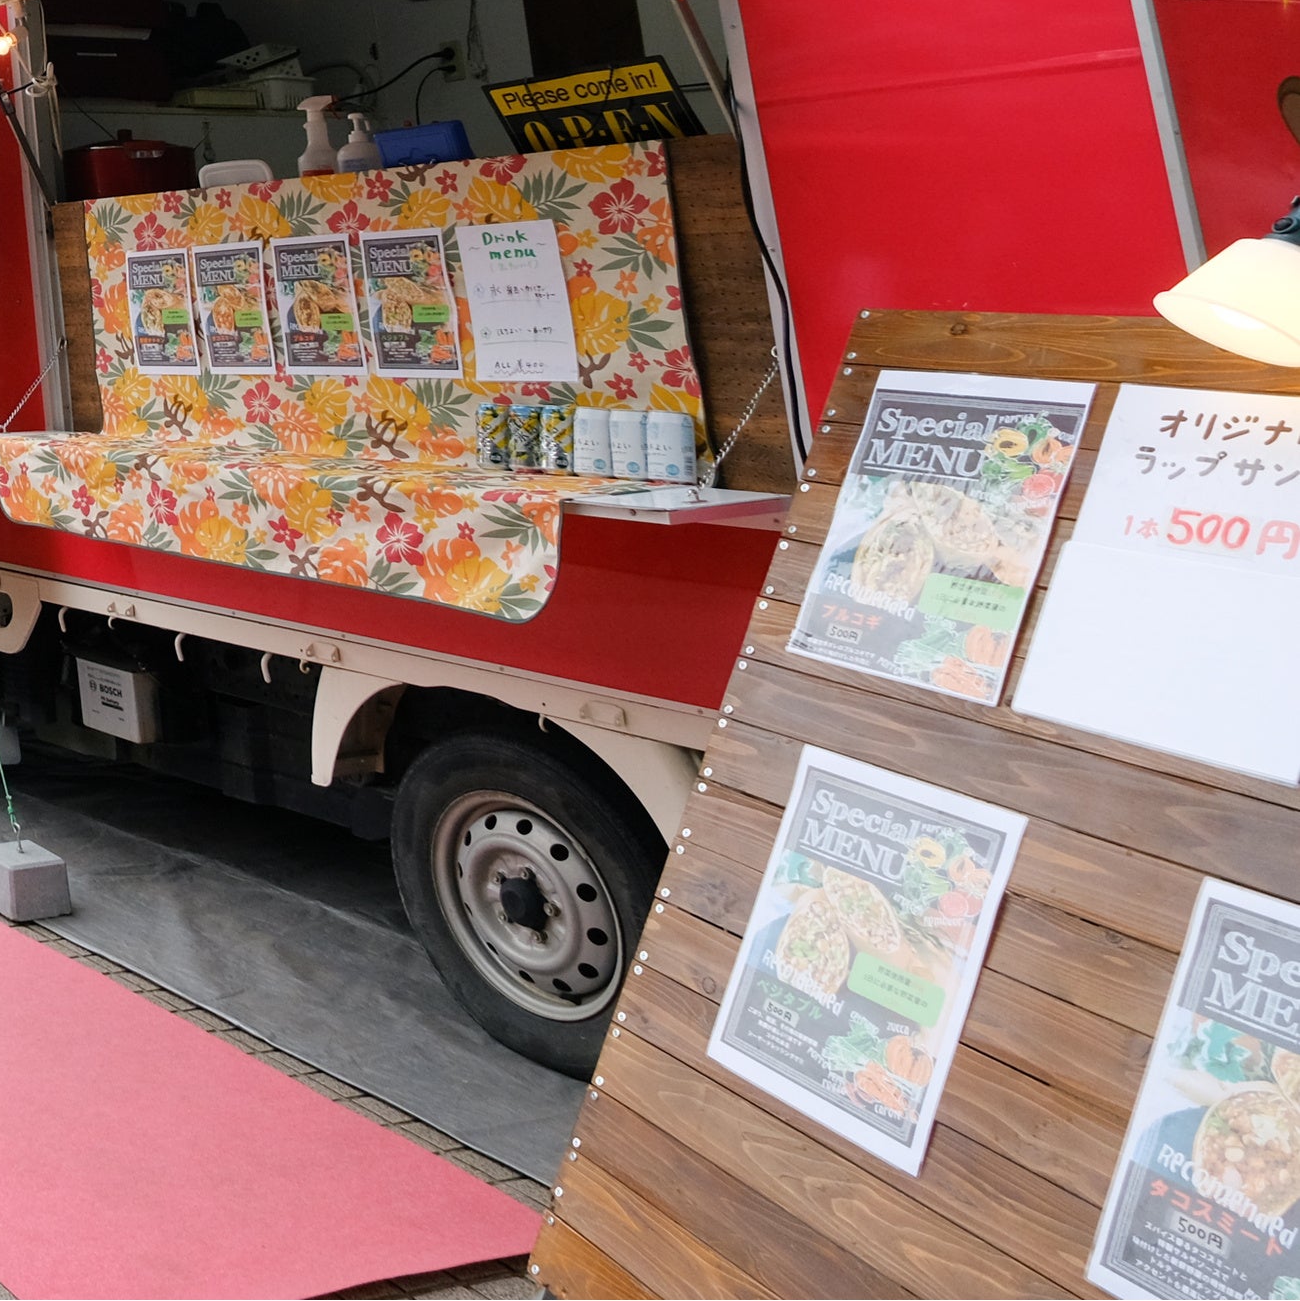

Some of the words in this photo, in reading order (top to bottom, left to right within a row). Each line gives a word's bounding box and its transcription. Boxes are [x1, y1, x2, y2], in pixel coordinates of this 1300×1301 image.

[502, 86, 571, 110] Please
[574, 75, 629, 99] come
[279, 249, 319, 265] Special
[369, 243, 409, 260] Special
[489, 248, 537, 260] menu
[131, 261, 165, 275] Special
[200, 257, 235, 271] Special
[280, 263, 322, 278] MENU
[371, 259, 413, 275] MENU
[132, 273, 165, 286] MENU
[201, 269, 236, 283] MENU
[875, 407, 999, 444] Special
[1159, 409, 1300, 446] オリジナ
[863, 438, 987, 478] MENU
[829, 625, 860, 642] 500円
[99, 683, 123, 698] BOSCH
[810, 788, 921, 846] Special
[798, 817, 907, 880] MENU
[766, 1002, 793, 1022] 500円
[1150, 1179, 1284, 1257] タコスミート
[1177, 1216, 1224, 1250] 500円
